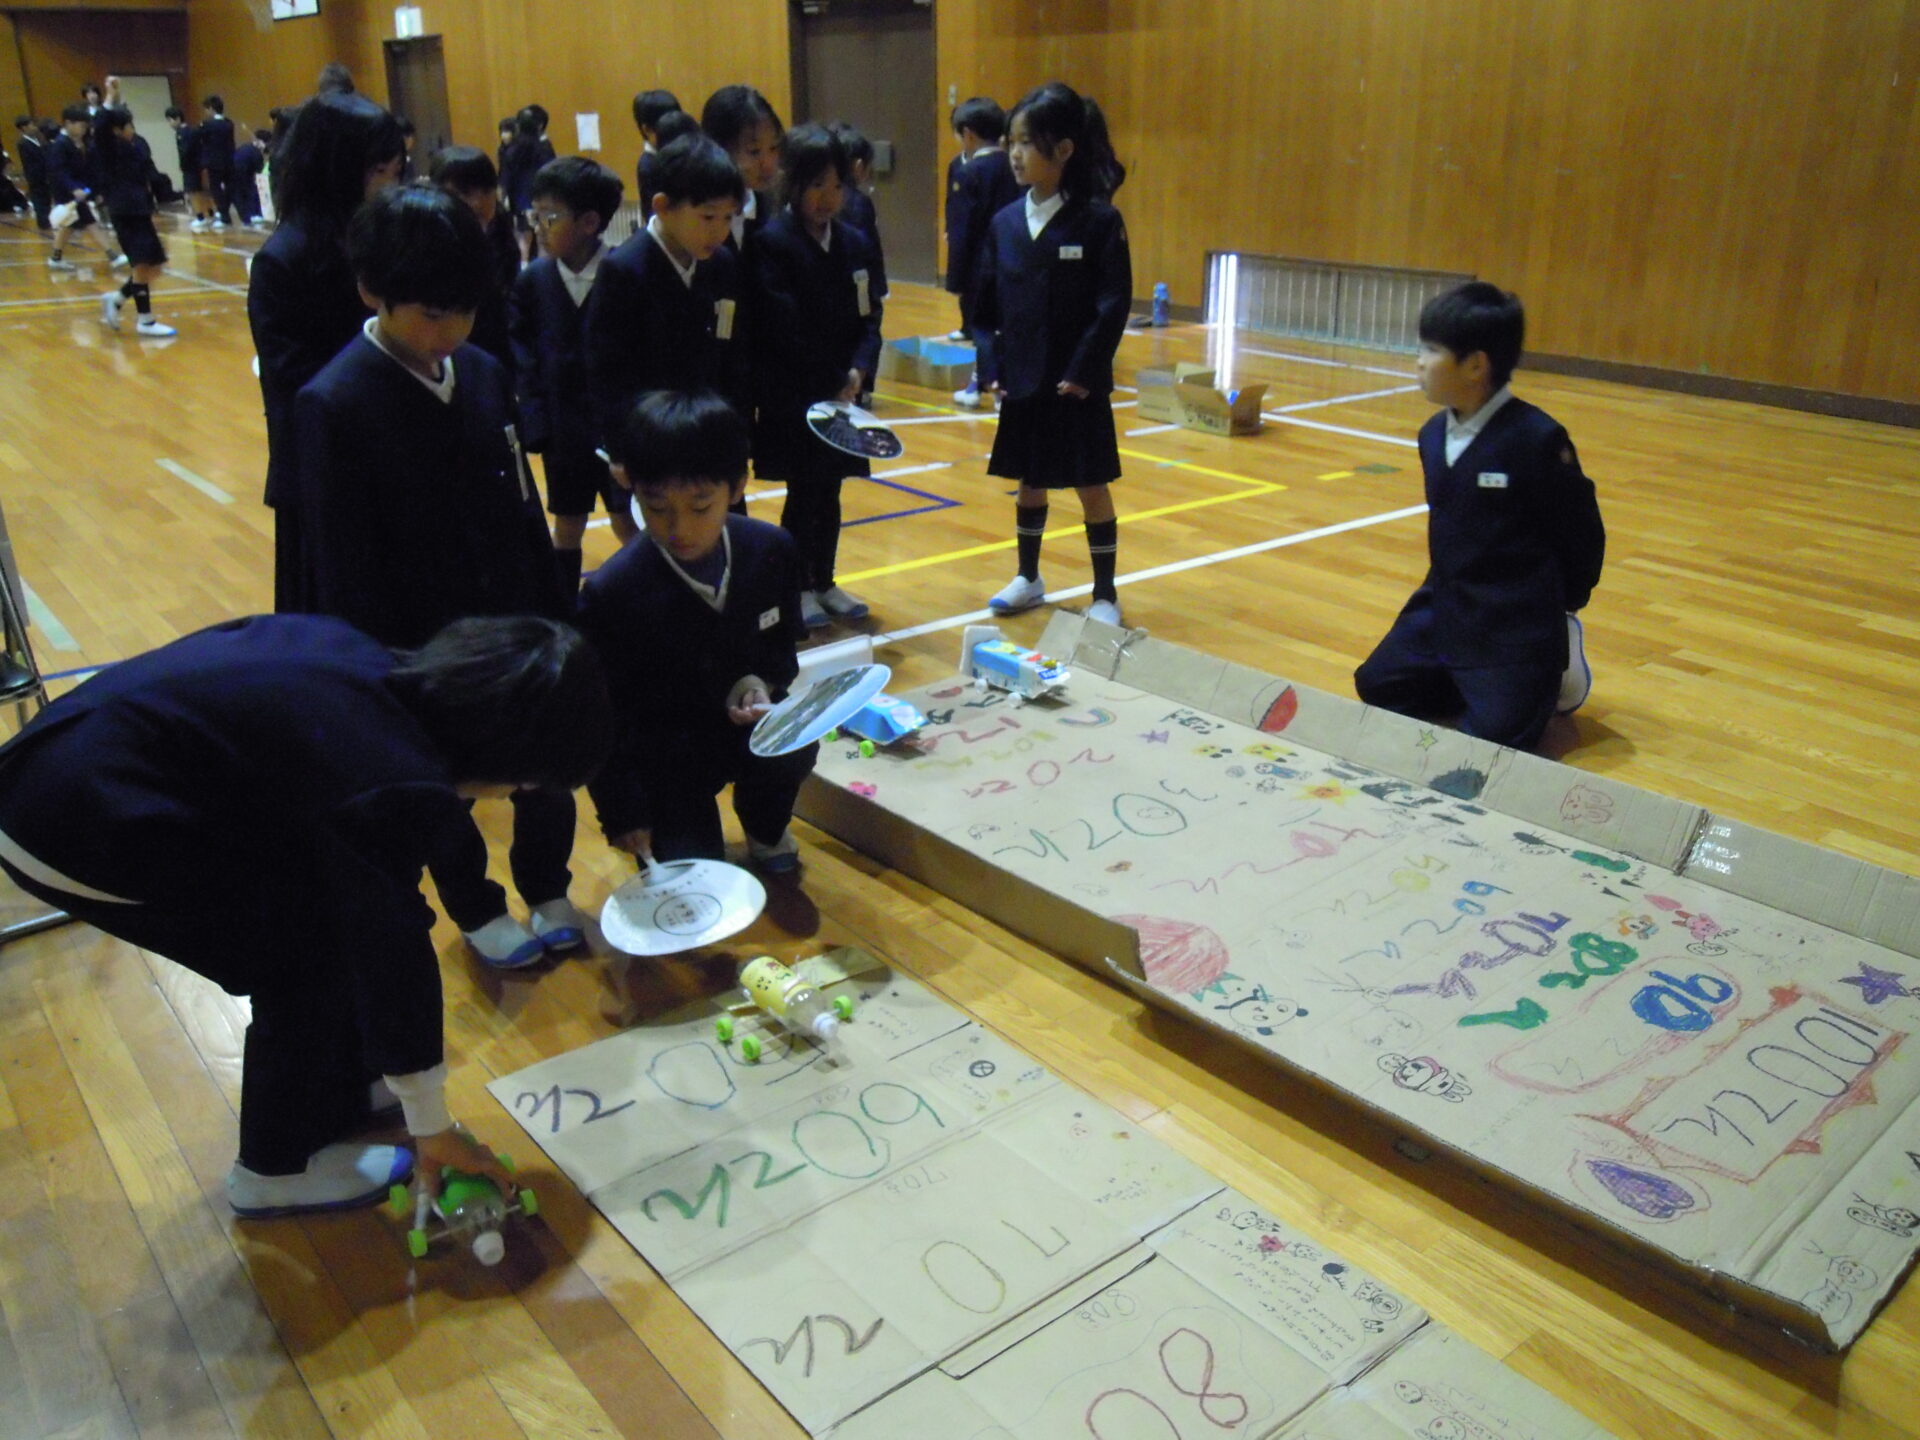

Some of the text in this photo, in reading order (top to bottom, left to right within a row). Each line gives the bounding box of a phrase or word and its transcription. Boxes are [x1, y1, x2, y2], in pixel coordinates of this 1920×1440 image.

[961, 748, 1115, 799] 20てん
[993, 779, 1218, 862] 30てん
[1150, 820, 1386, 894] 40てん
[1292, 853, 1449, 921] 50てん
[1338, 880, 1514, 963] 60てん
[1391, 911, 1571, 1000] 70てん
[1458, 931, 1639, 1031] 80てん
[1526, 970, 1733, 1082] 90てん
[1656, 1007, 1880, 1147] 100てん
[640, 1082, 946, 1228] 60てん
[737, 1218, 1072, 1378] 70てん
